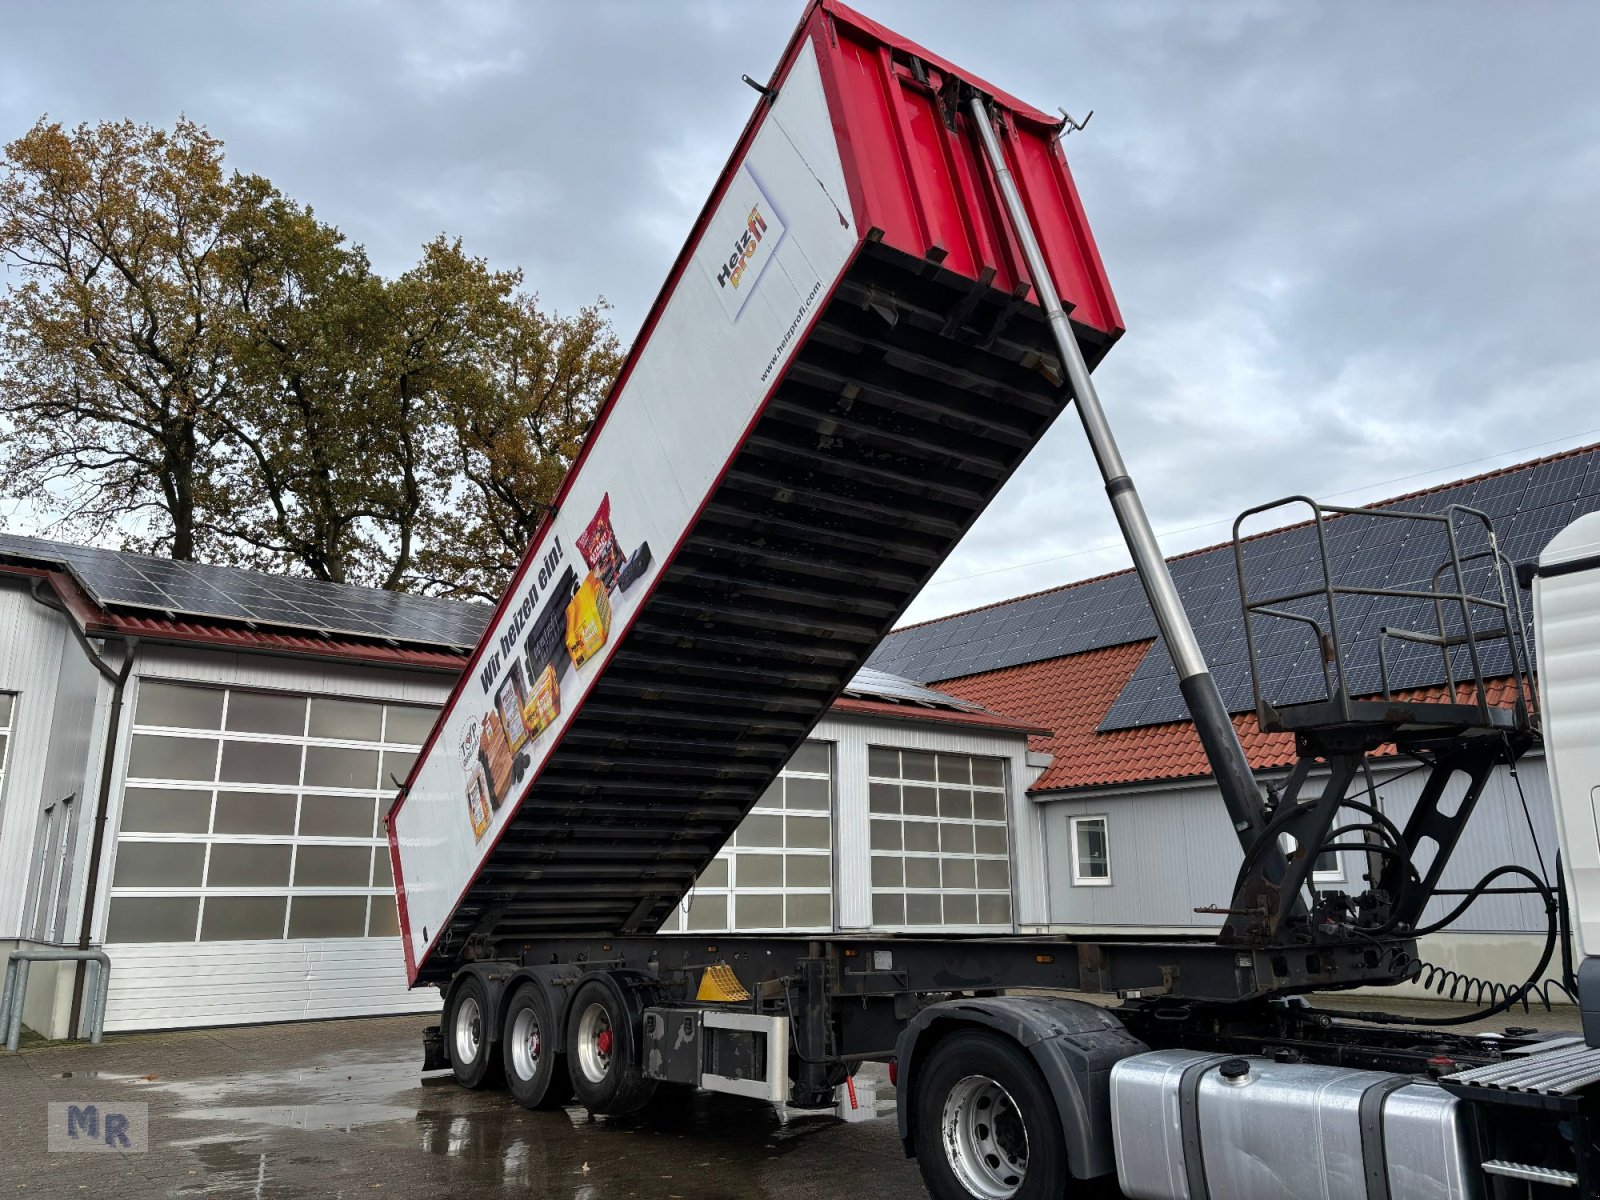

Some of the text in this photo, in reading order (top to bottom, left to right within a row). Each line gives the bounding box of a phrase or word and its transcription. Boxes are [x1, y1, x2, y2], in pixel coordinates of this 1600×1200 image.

[717, 229, 752, 288] Heiz
[760, 280, 822, 383] www.heizprofi.com
[480, 649, 502, 695] Wir
[500, 583, 539, 660] heizen
[538, 535, 564, 590] ein!
